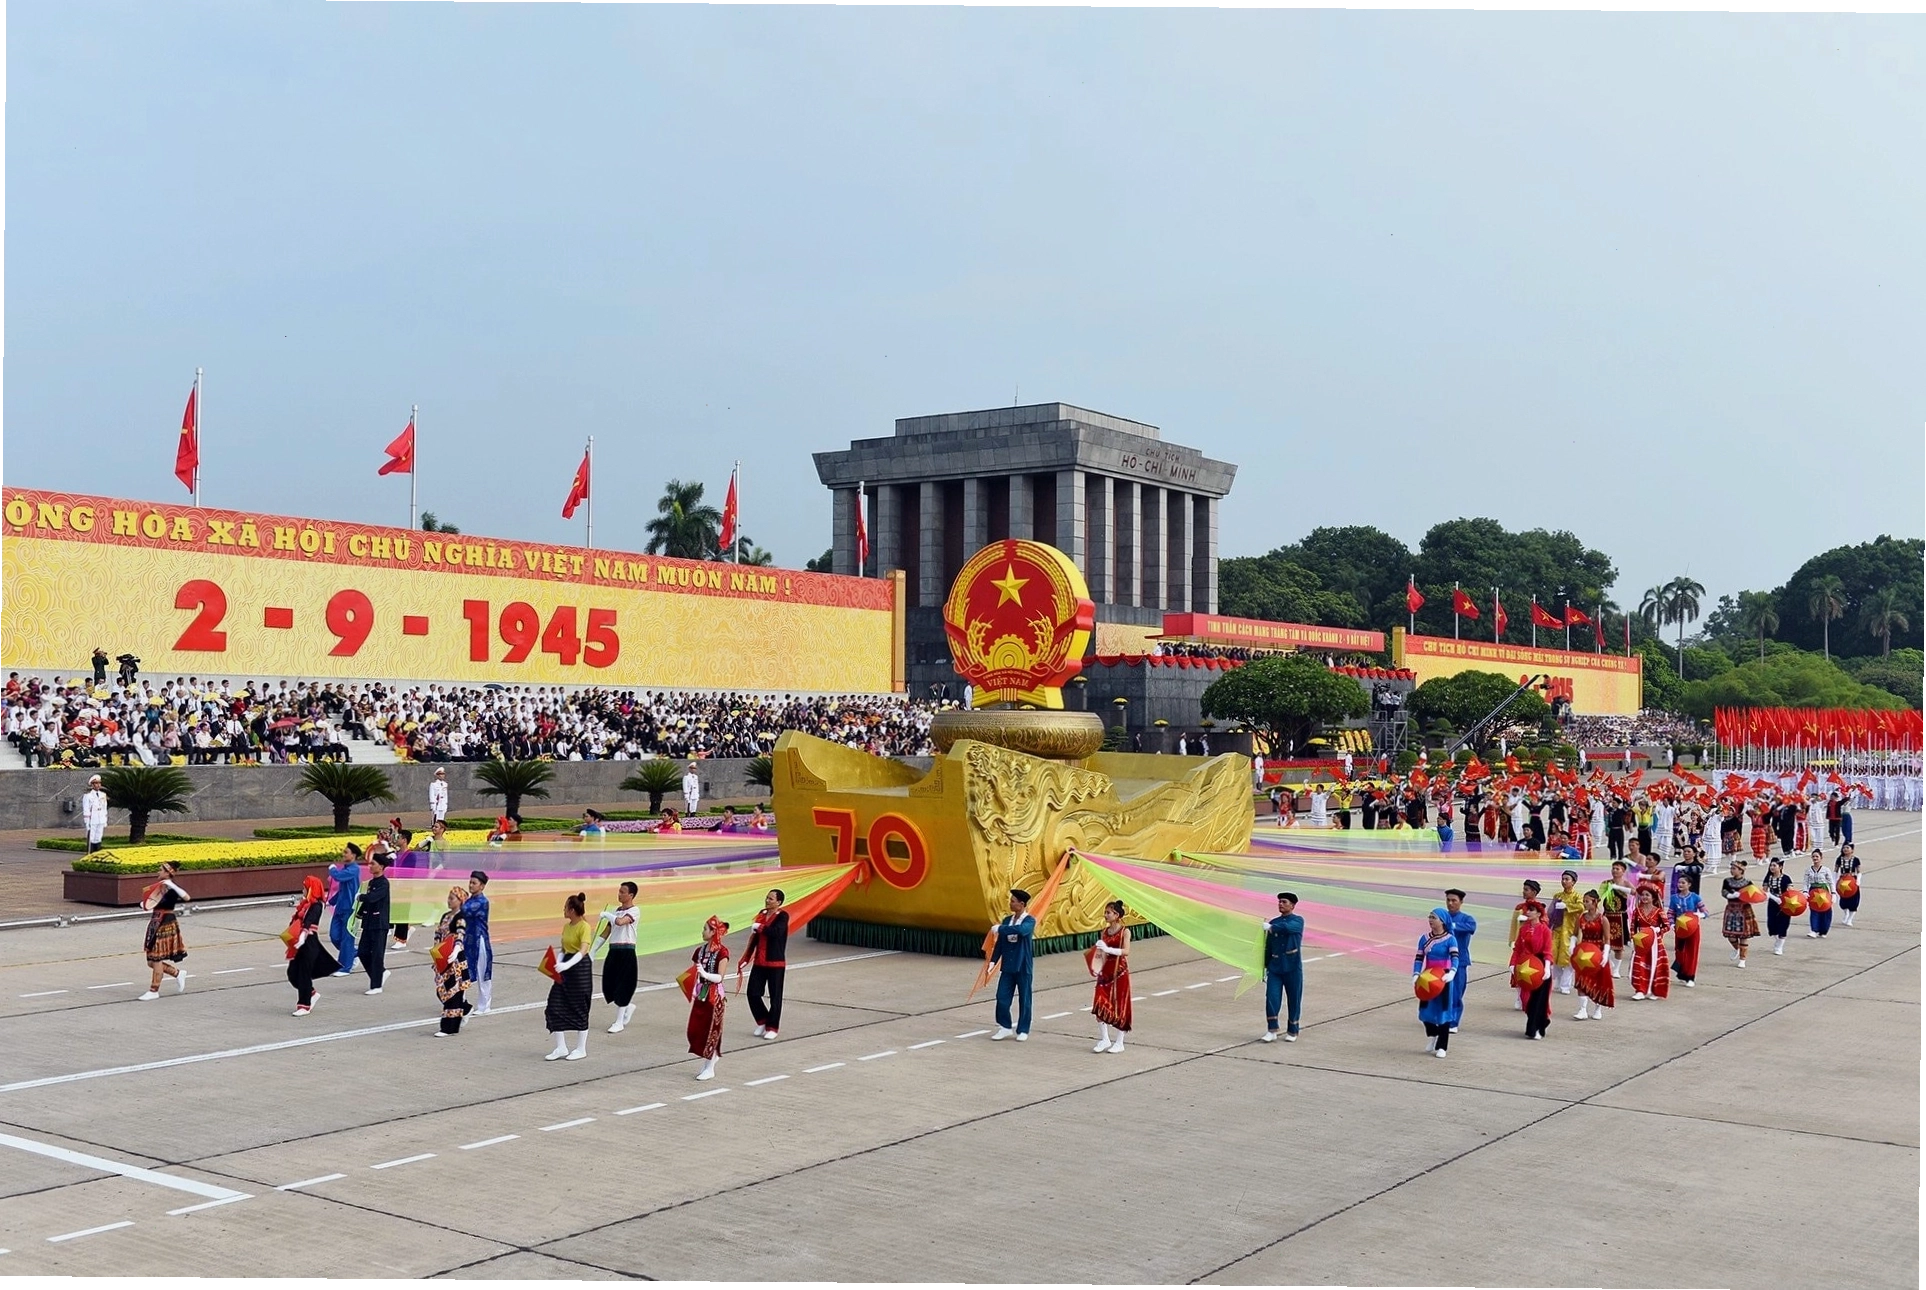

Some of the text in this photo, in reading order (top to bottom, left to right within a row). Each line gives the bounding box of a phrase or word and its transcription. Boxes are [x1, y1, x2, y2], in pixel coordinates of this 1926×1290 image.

[112, 508, 194, 541] HÒA
[207, 518, 260, 548] XÃ
[274, 525, 335, 558] HỘI
[349, 532, 411, 561] CHỦ
[423, 541, 514, 569] NGHĨA
[524, 549, 584, 578] VIỆT
[593, 558, 648, 583] NAM
[657, 565, 723, 589] MUÔN
[730, 571, 777, 594] NĂM
[172, 579, 228, 652] 2
[325, 588, 374, 656] 9
[463, 599, 620, 668] 1945
[1010, 677, 1029, 687] NAM
